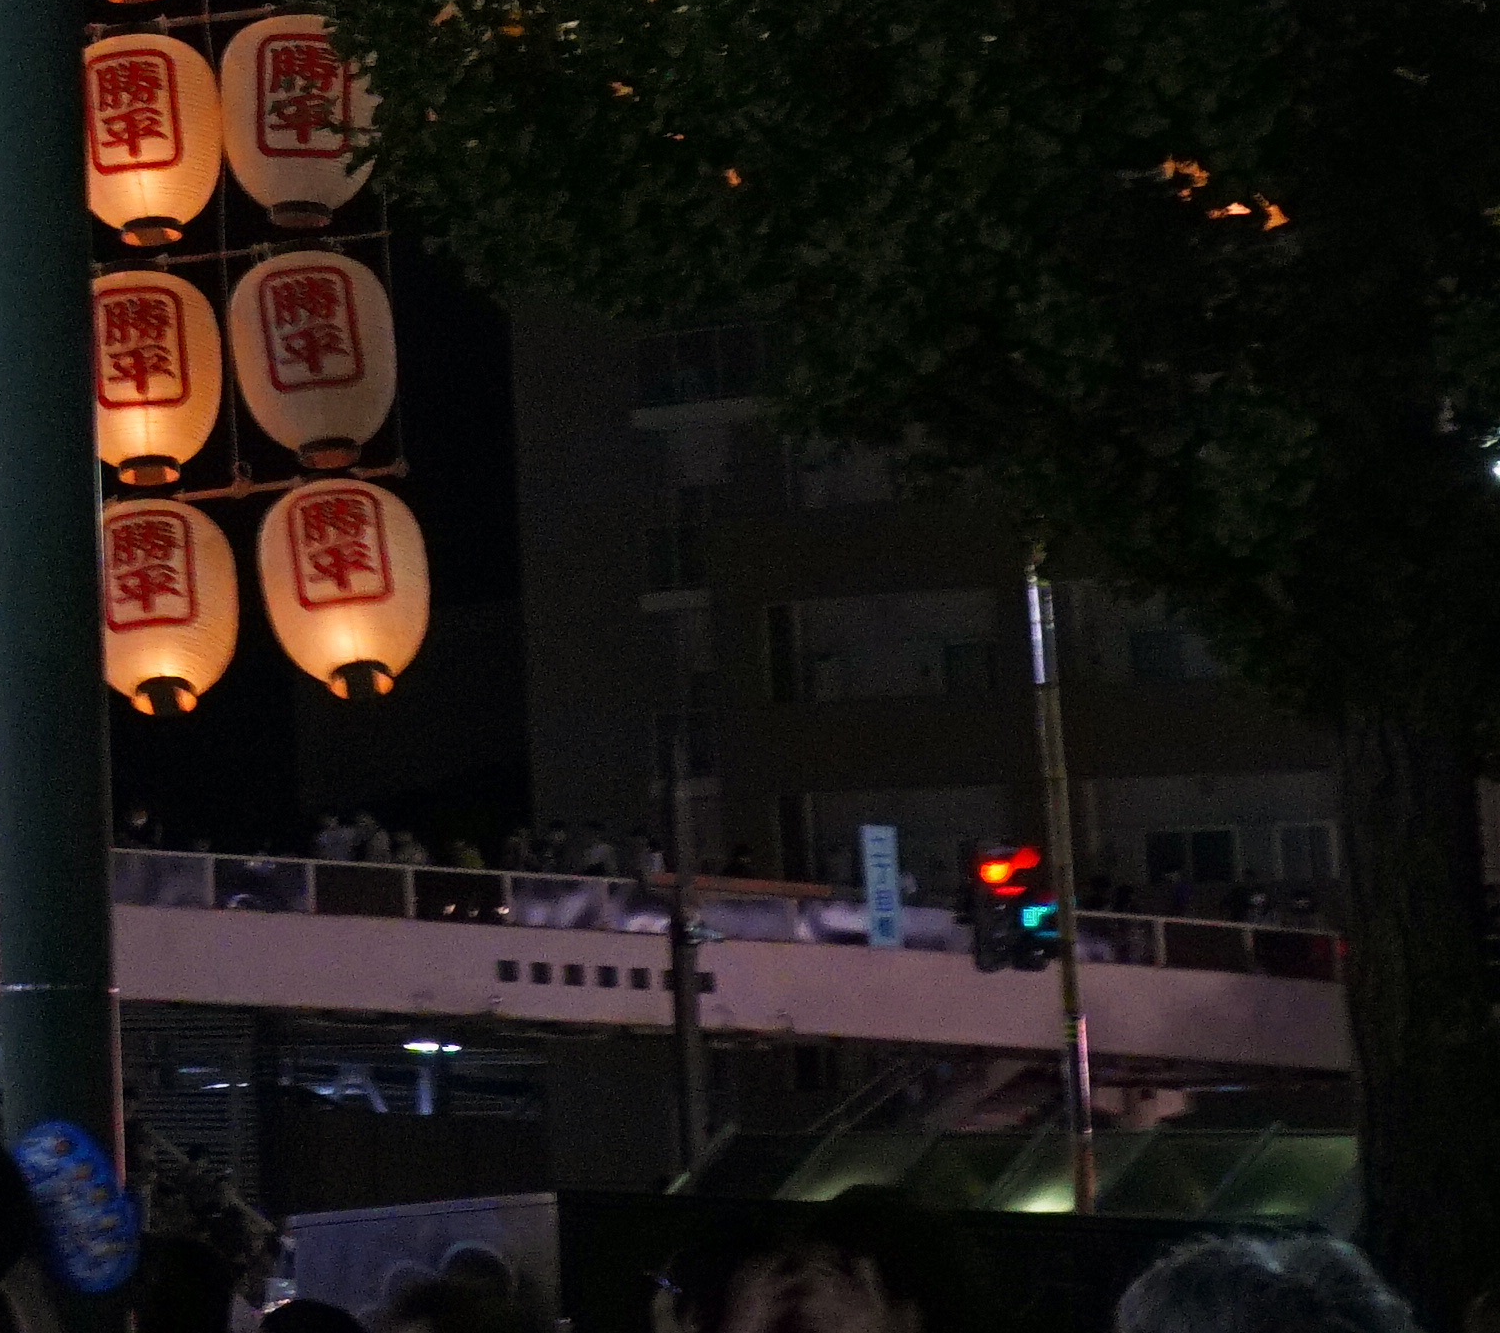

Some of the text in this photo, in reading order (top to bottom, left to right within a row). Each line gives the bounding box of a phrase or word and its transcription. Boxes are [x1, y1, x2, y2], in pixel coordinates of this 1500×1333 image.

[96, 63, 168, 157] 勝平
[104, 299, 177, 394] 勝平
[273, 276, 349, 373] 勝平
[113, 520, 182, 612] 勝平
[304, 498, 377, 591] 勝平
